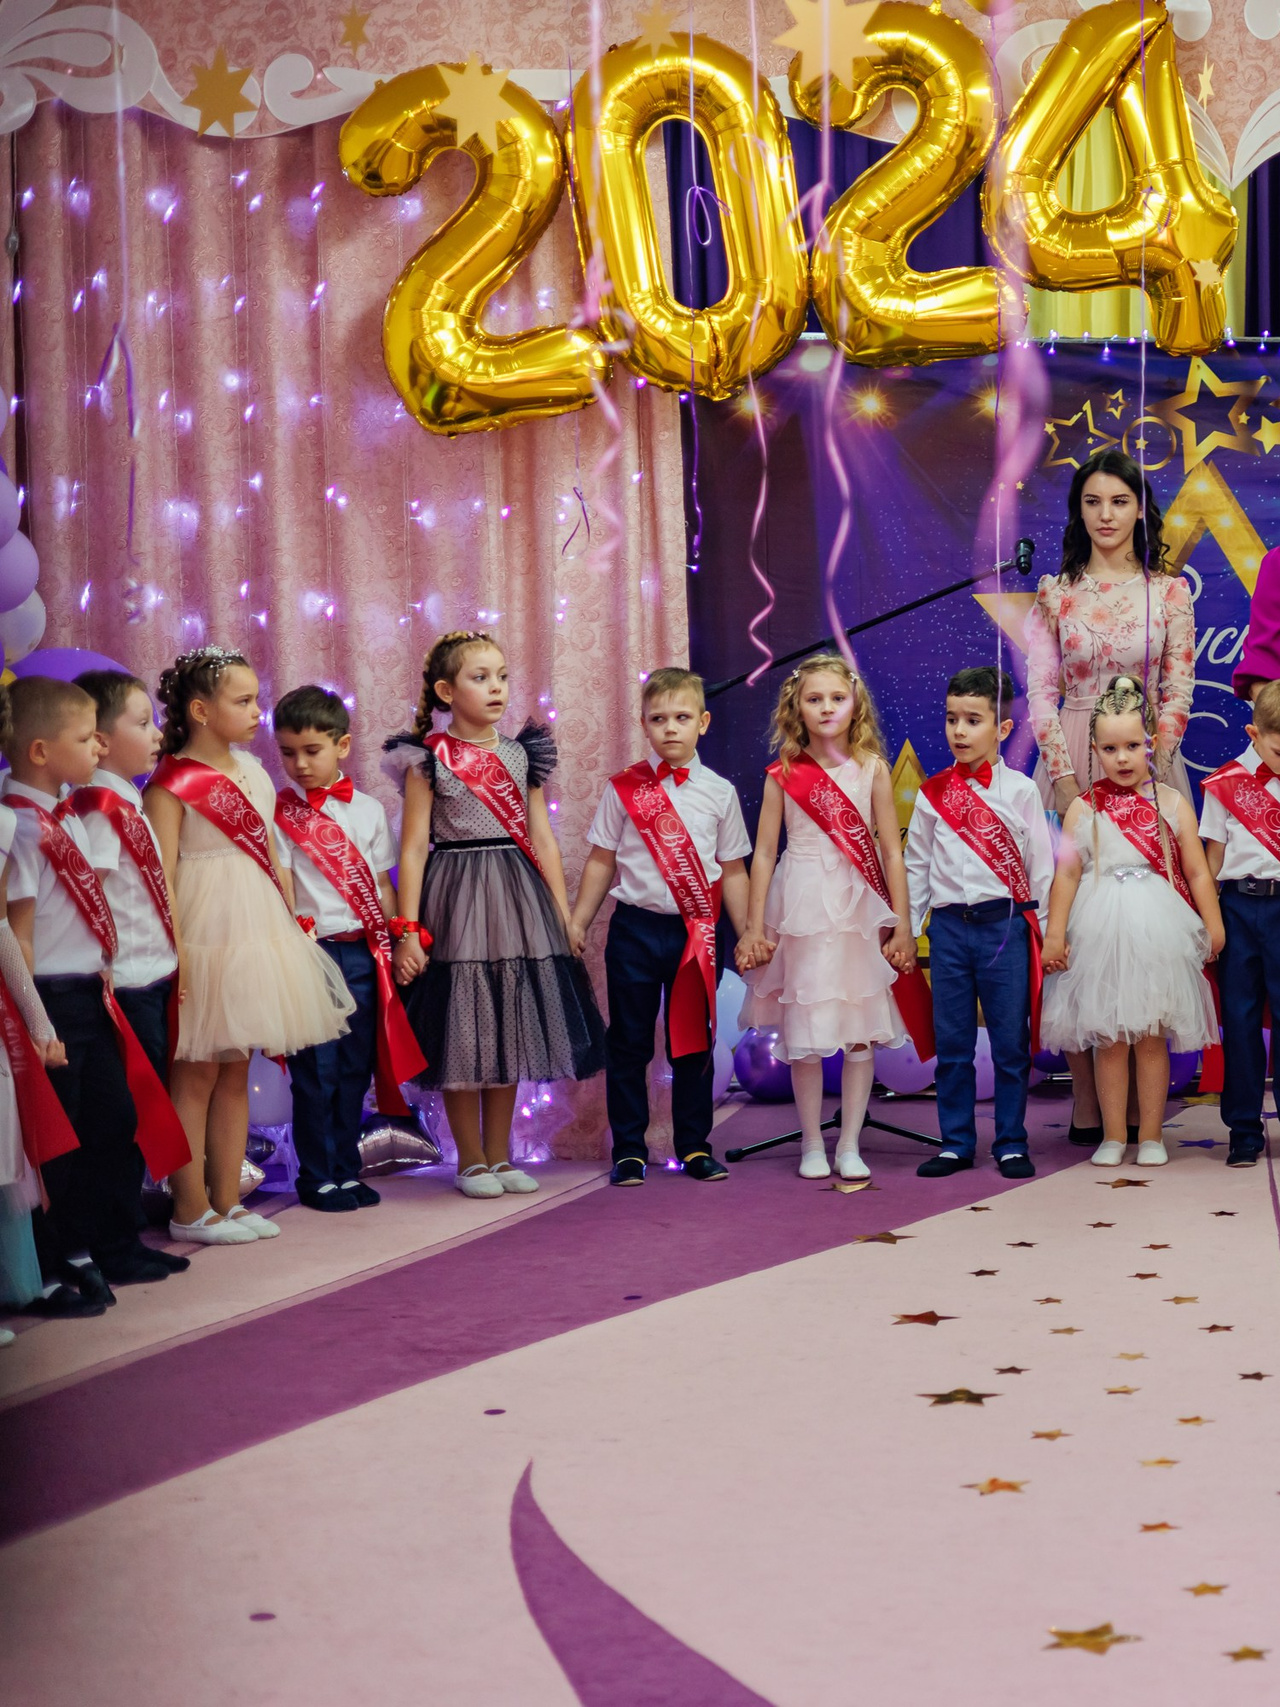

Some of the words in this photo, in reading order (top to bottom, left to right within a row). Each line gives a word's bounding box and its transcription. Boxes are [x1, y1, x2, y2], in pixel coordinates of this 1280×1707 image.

[339, 0, 1238, 437] 2024
[473, 784, 509, 820] детского
[507, 819, 525, 838] сада
[300, 840, 338, 876] детского
[336, 876, 354, 896] сада
[640, 827, 669, 867] детского
[665, 865, 681, 888] сада
[654, 812, 714, 919] Выпускник
[827, 828, 863, 862] детского
[956, 826, 993, 859] детского
[991, 858, 1009, 877] сада
[1120, 827, 1158, 858] детского
[1157, 858, 1168, 873] сад
[314, 821, 385, 926] Выпускник
